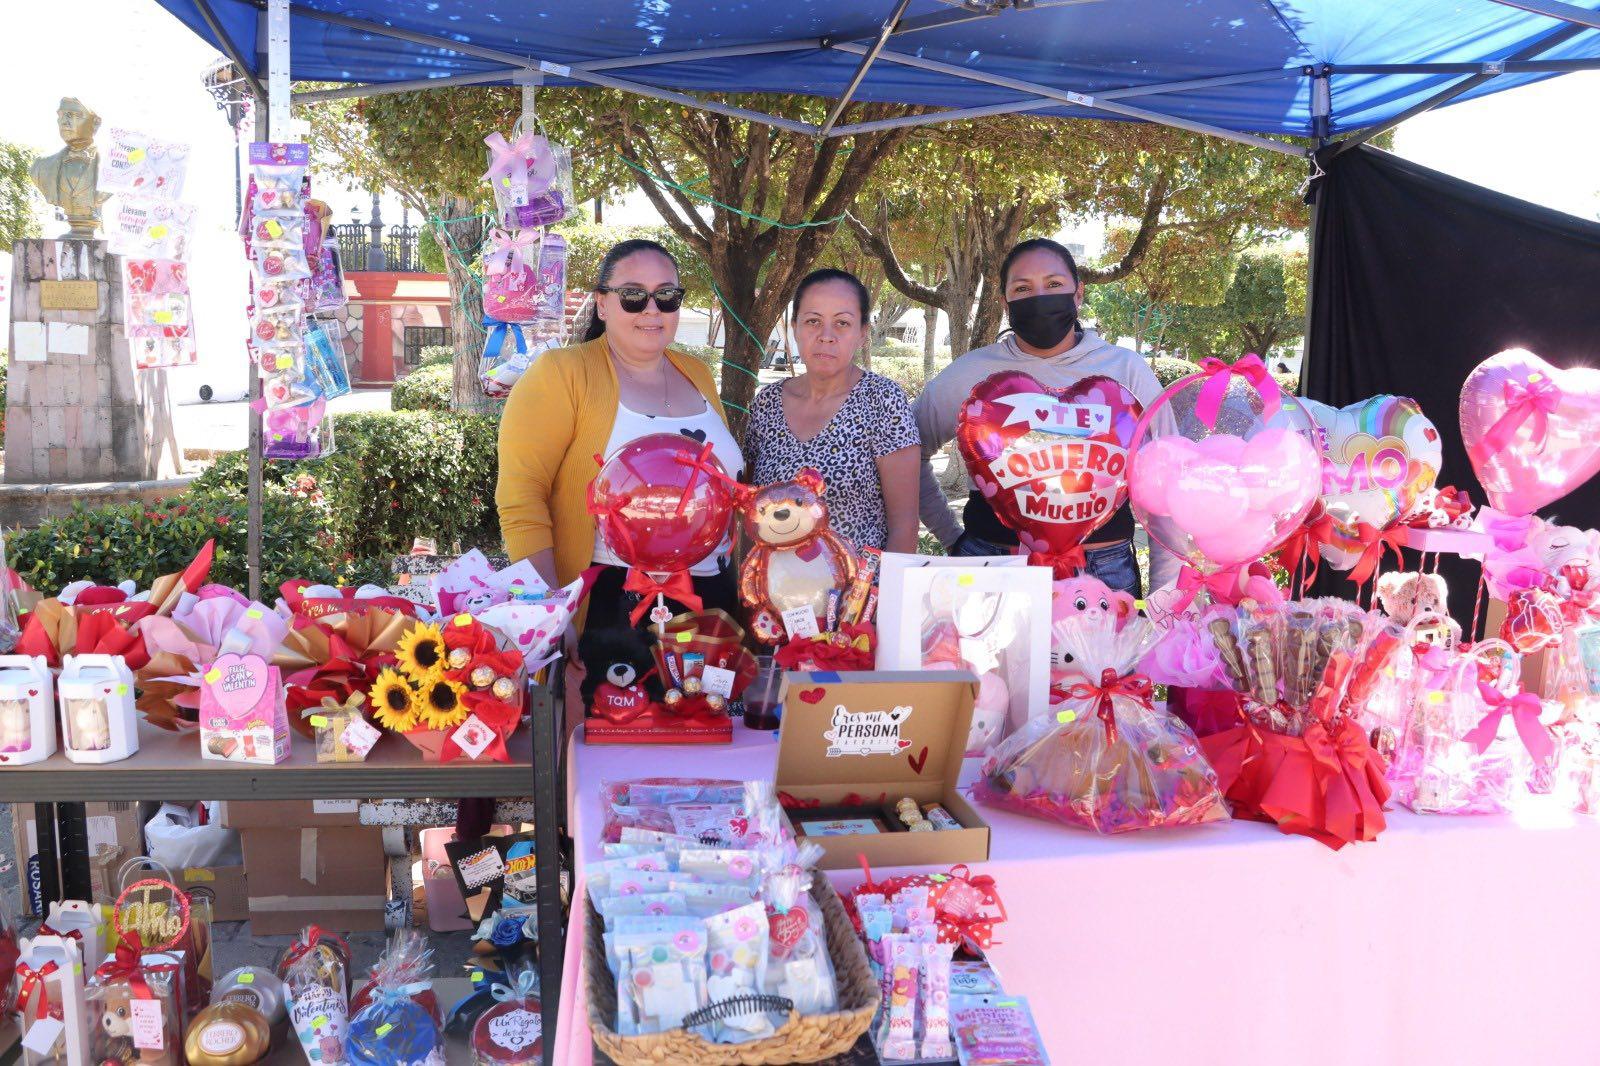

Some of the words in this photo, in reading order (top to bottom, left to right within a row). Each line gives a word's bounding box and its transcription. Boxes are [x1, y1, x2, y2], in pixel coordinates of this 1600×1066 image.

[1051, 404, 1091, 429] TE
[1007, 443, 1126, 478] QUIERO
[1321, 448, 1408, 496] MO
[1025, 495, 1108, 520] MUCHO
[231, 672, 246, 681] SAN
[607, 694, 635, 707] TQM
[833, 707, 861, 727] Eres
[838, 724, 899, 738] PERSONA
[226, 994, 257, 1002] FERRERO
